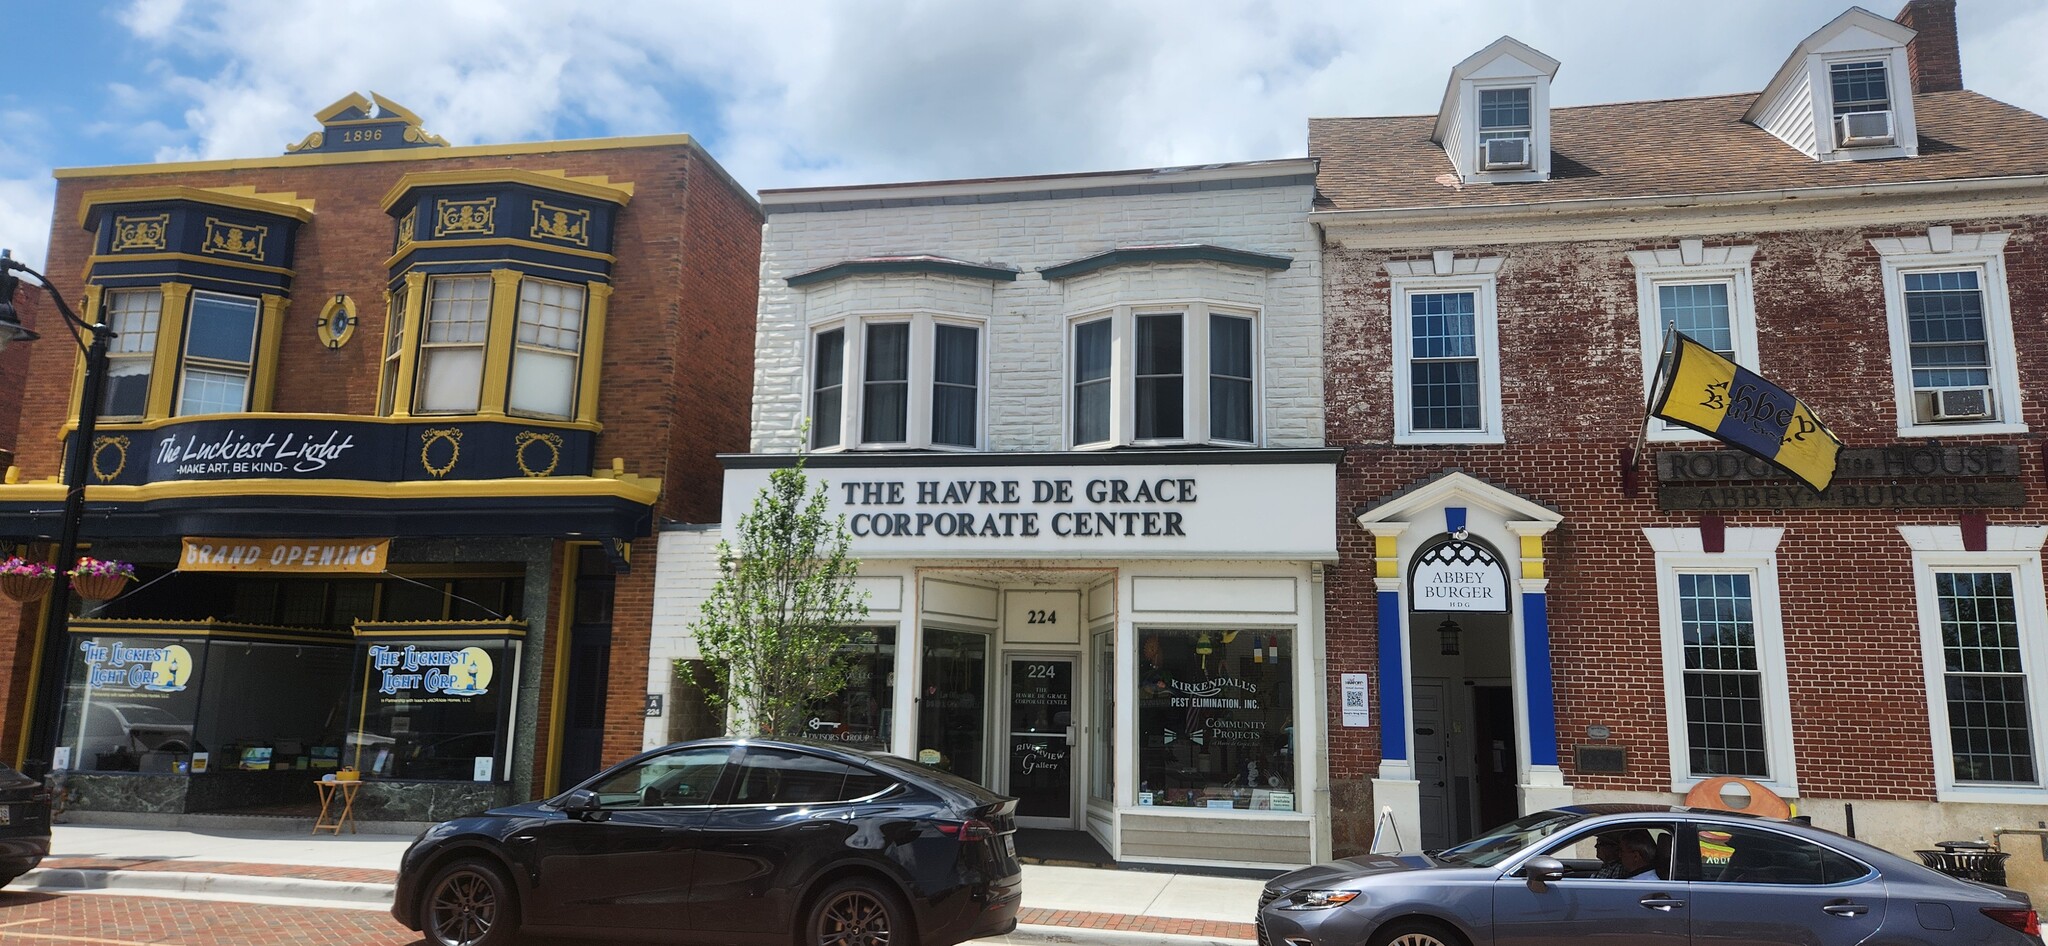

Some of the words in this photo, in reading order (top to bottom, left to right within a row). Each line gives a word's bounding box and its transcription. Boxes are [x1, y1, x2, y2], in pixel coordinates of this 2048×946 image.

[344, 130, 383, 142] 1896
[1707, 378, 1816, 442] Abbey
[156, 434, 182, 464] The
[182, 430, 276, 461] Luckiest
[275, 430, 355, 472] Light
[207, 463, 231, 475] ART,
[233, 463, 250, 473] BE
[1883, 449, 2007, 475] HOUSE
[841, 481, 905, 505] THE
[917, 480, 1021, 504] HAVRE
[1032, 480, 1074, 504] DE
[1085, 478, 1198, 503] GRACE
[1698, 485, 1802, 508] ABBEY
[1840, 484, 1986, 506] BURGER
[850, 512, 1040, 538] CORPORATE
[1051, 511, 1187, 537] CENTER
[186, 543, 262, 565] GRAND
[270, 544, 378, 566] OPENING
[1432, 572, 1485, 584] ABBEY
[1425, 586, 1494, 599] BURGER
[1028, 610, 1057, 624] 224
[80, 640, 109, 665] THE
[108, 641, 172, 667] LUCKIEST
[369, 645, 400, 671] THE
[401, 644, 470, 672] LUCKIEST
[90, 662, 127, 689] LIGHT
[379, 667, 423, 695] LIGHT
[1028, 665, 1056, 678] 224
[1171, 677, 1258, 694] KIRKENDALL'S
[650, 699, 657, 707] A
[1171, 697, 1189, 708] PEST
[1192, 697, 1242, 709] ELIMINATION,
[1244, 699, 1260, 709] INC.
[1205, 718, 1267, 730] COMMUNITY
[802, 731, 840, 741] ADVISORS
[841, 731, 870, 742] GROUP
[1212, 728, 1260, 740] PROJECTS
[1022, 753, 1058, 775] Gallery
